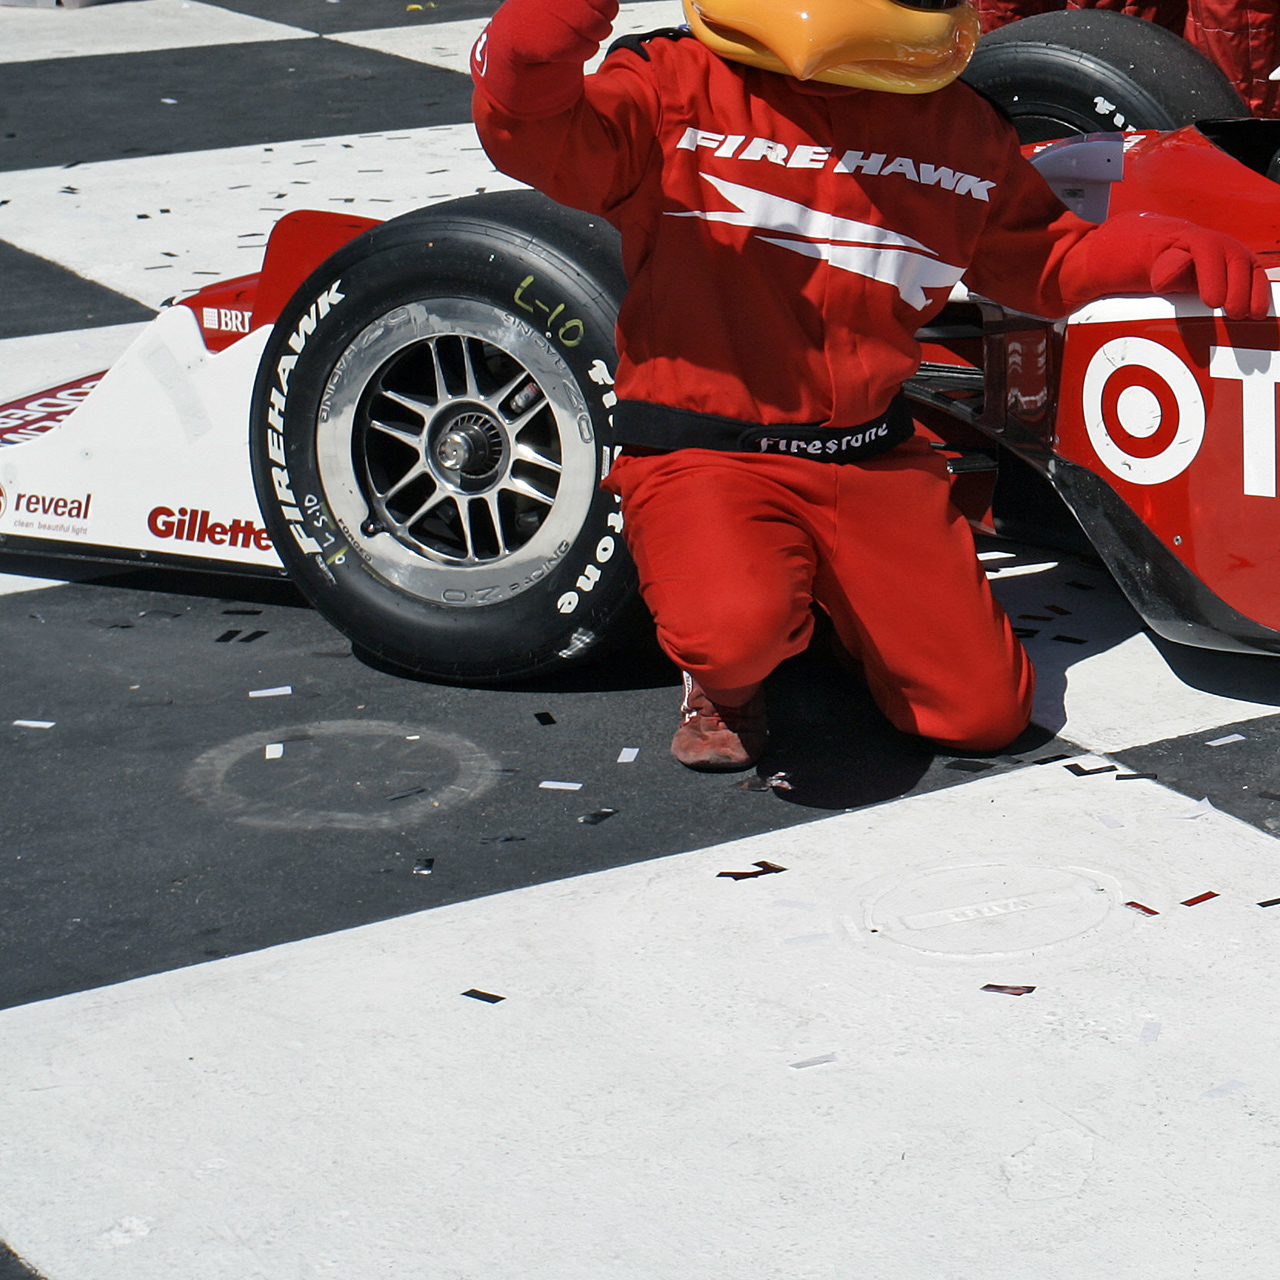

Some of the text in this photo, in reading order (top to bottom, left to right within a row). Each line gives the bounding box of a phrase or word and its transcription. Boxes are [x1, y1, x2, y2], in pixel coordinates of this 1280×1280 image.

[676, 128, 996, 203] FIRE HAWK
[267, 278, 347, 556] FIREHAWK
[757, 421, 889, 457] Firestone
[15, 492, 92, 520] reveal
[147, 506, 273, 551] Gillette
